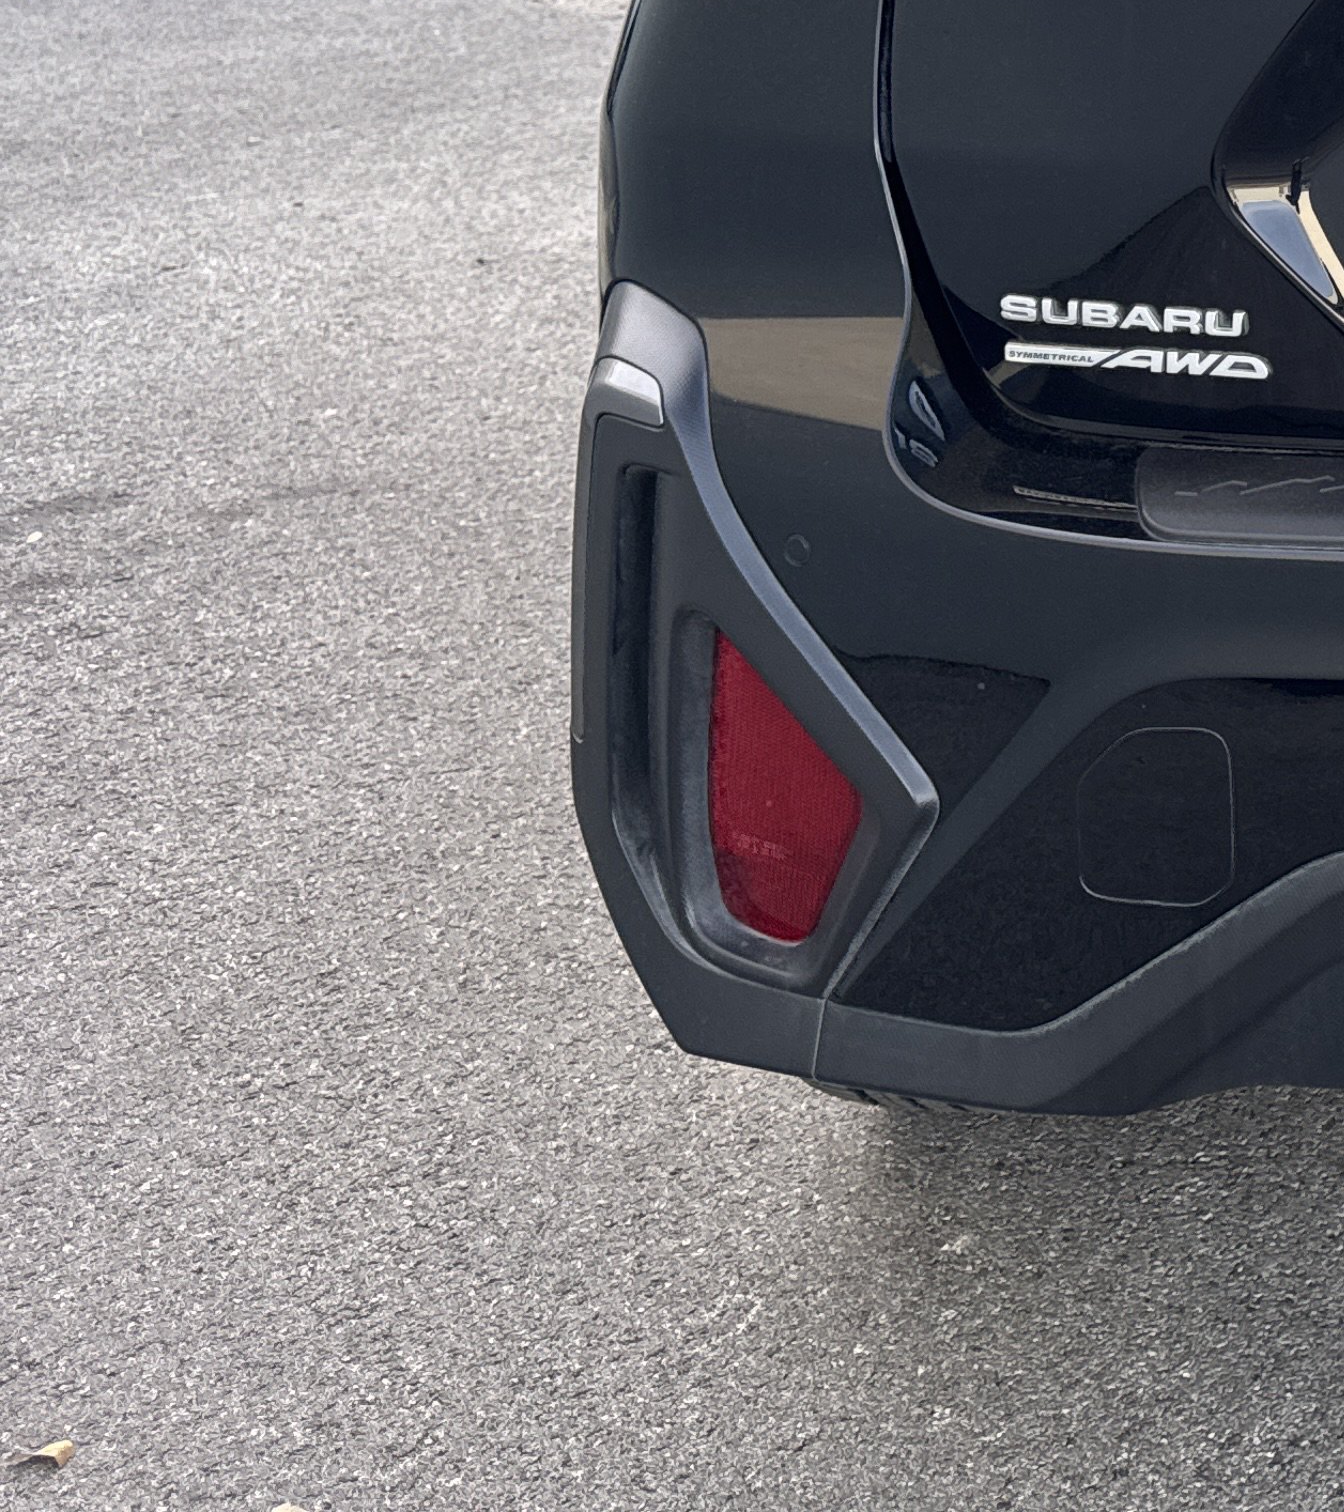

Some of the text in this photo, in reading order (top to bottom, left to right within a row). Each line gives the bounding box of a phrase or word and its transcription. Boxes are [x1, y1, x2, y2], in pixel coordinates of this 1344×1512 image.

[1000, 294, 1250, 338] SUBARU
[1008, 348, 1273, 380] SYMMETRICAL AWD
